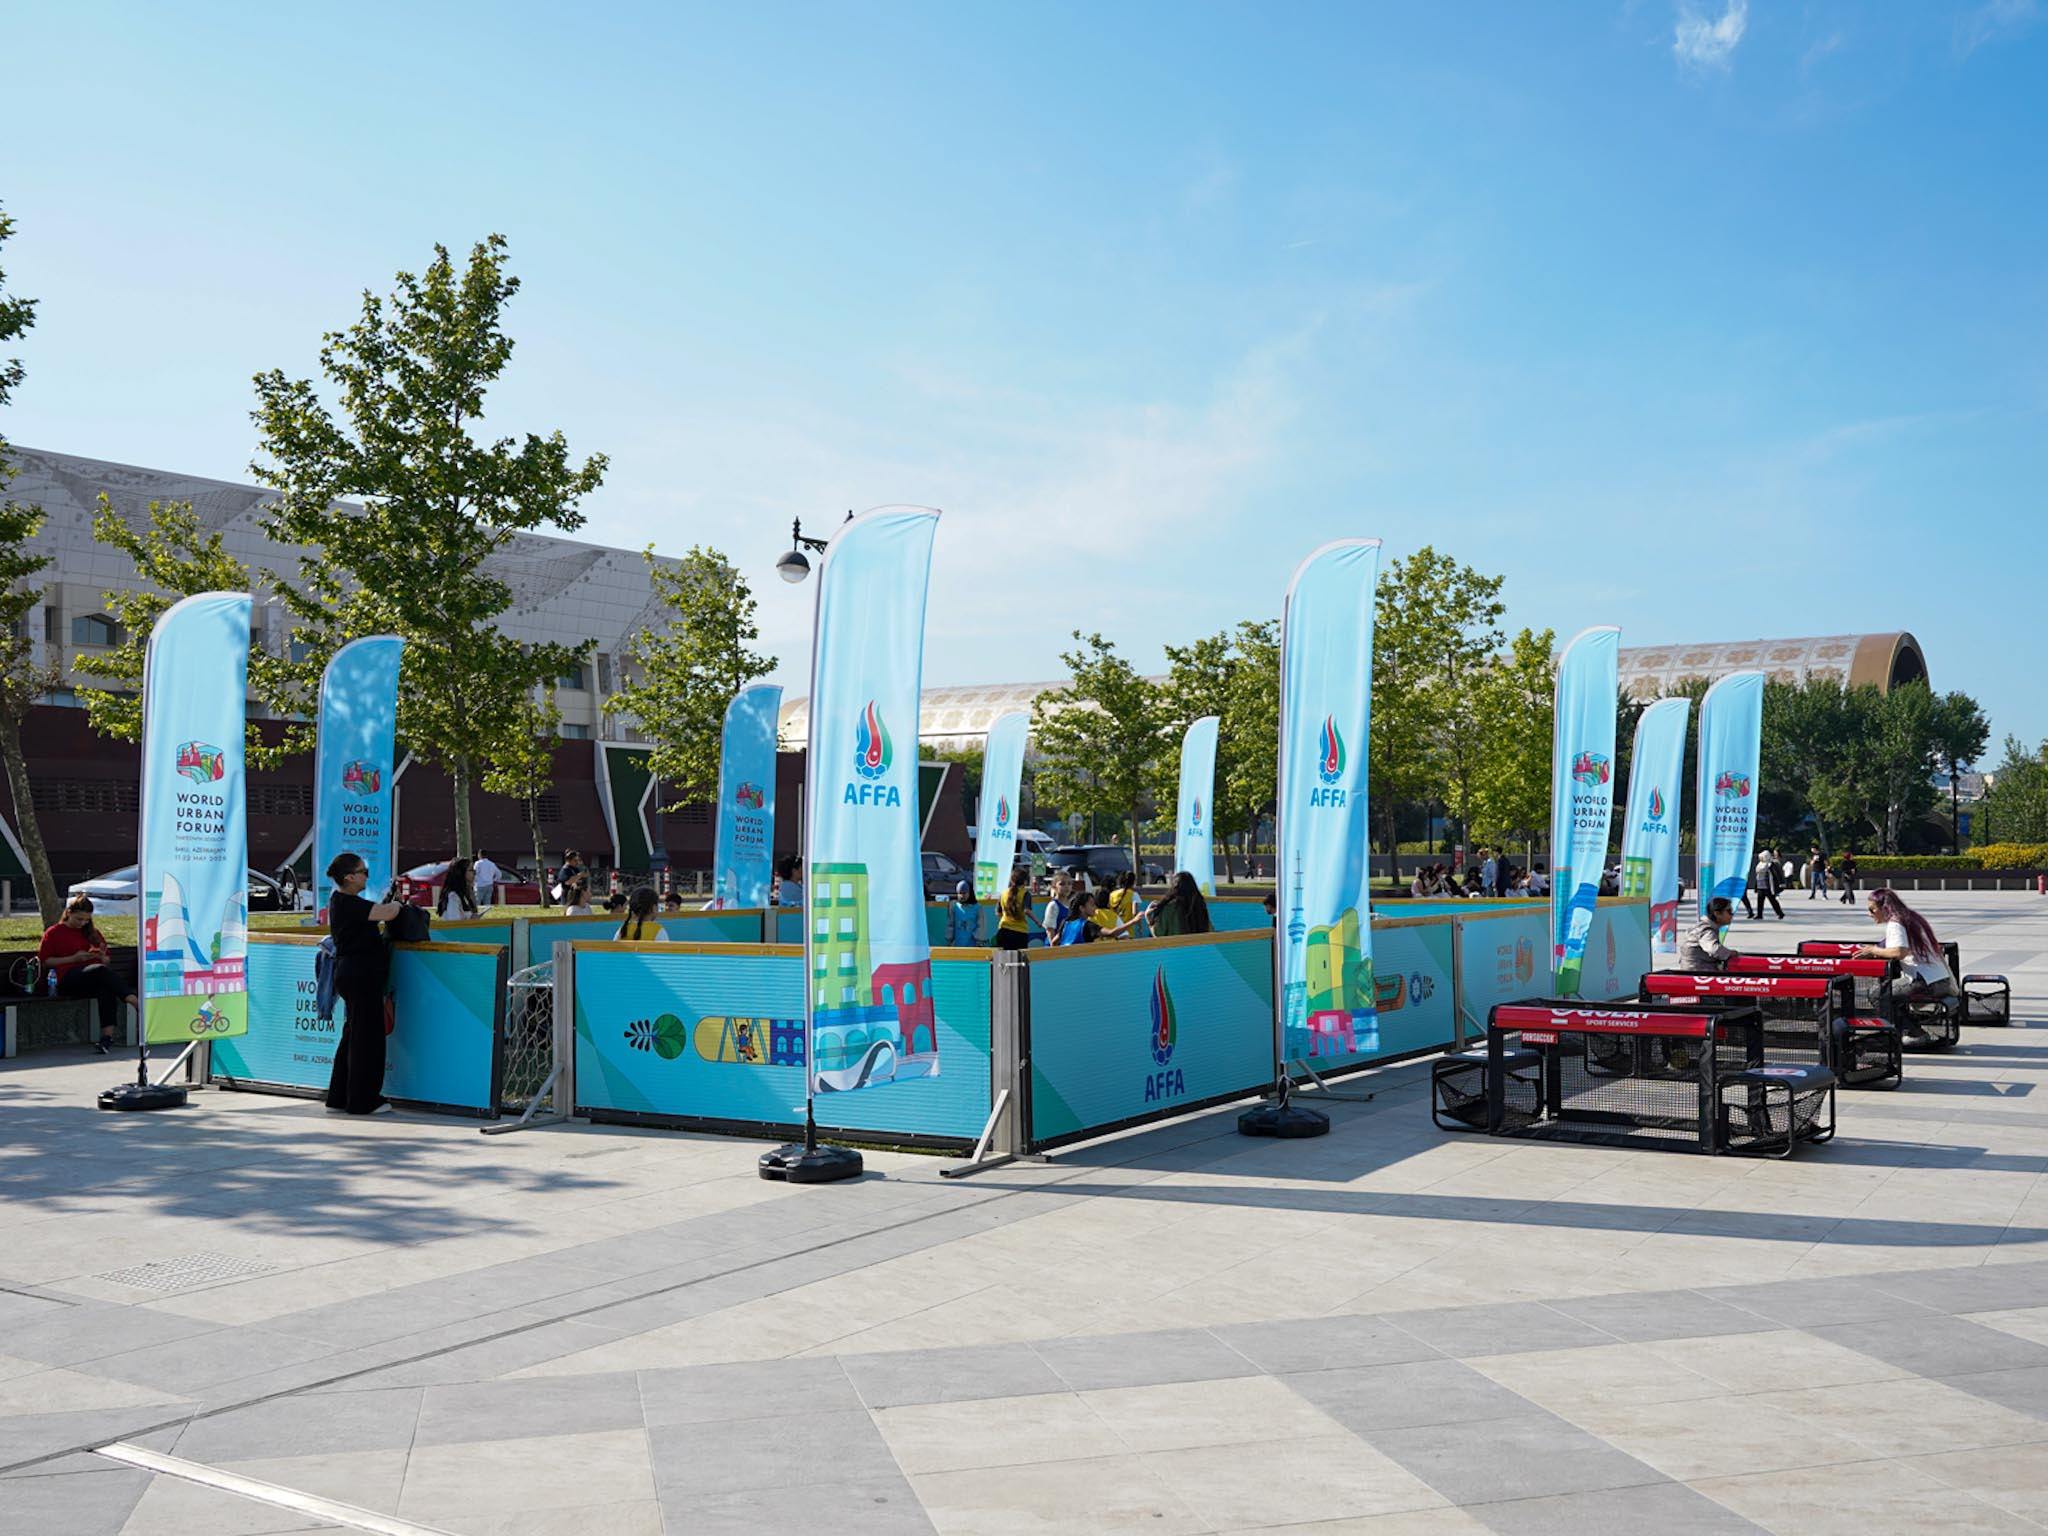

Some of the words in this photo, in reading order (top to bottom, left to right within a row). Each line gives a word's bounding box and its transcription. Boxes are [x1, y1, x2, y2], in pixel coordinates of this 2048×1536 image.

[177, 793, 224, 806] WORLD
[844, 783, 900, 807] AFFA
[1310, 787, 1346, 808] AFFA
[1573, 795, 1608, 806] WORLD
[177, 808, 224, 820] URBAN
[343, 804, 379, 814] WORLD
[1573, 807, 1606, 817] URBAN
[1715, 806, 1749, 814] WORLD
[343, 815, 379, 825] URBAN
[735, 815, 764, 825] WORLD
[1573, 819, 1605, 829] FORUM
[1715, 815, 1748, 823] URBAN
[176, 821, 225, 834] FORUM
[343, 828, 379, 837] FORUM
[735, 825, 763, 834] URBAN
[1641, 821, 1668, 834] AFFA
[735, 834, 764, 843] FORUM
[992, 828, 1012, 840] AFFA
[295, 1017, 335, 1032] FORUM
[1585, 1019, 1606, 1027] SPORT
[1608, 1020, 1639, 1028] SERVICES
[1145, 1068, 1185, 1103] AFFA
